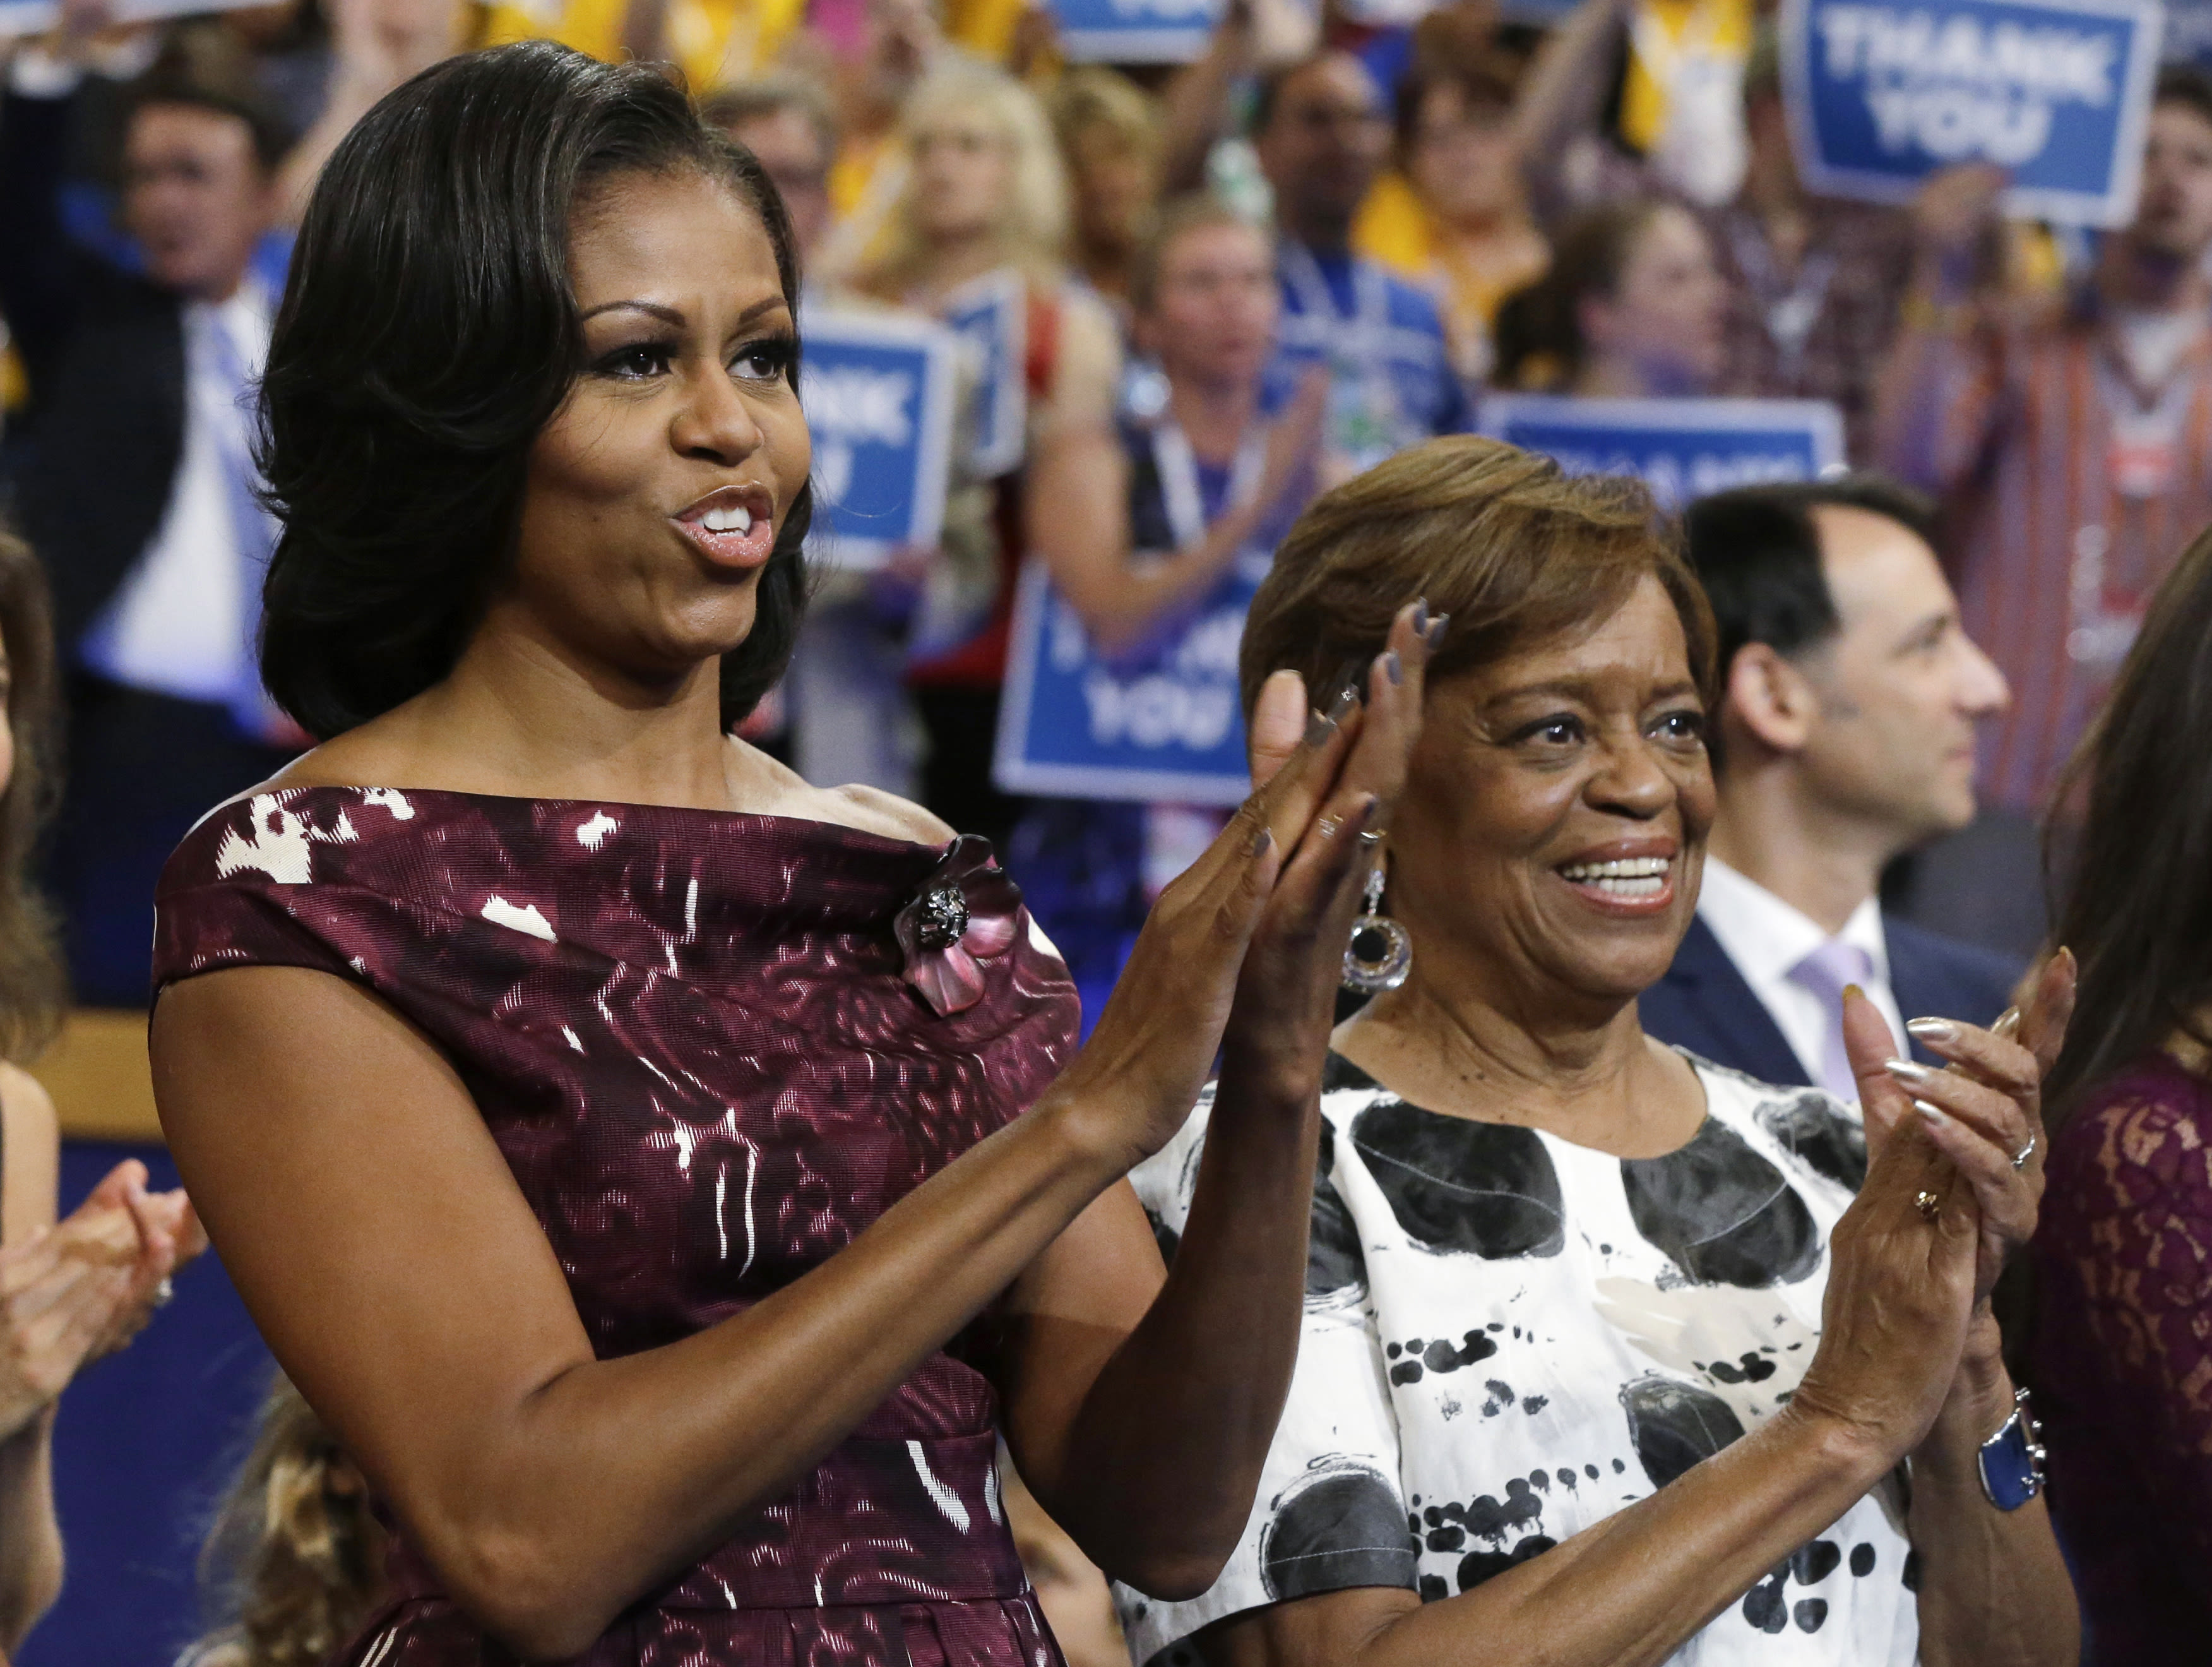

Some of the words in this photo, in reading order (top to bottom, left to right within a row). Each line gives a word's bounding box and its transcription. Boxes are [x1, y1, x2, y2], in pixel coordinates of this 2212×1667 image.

[1822, 5, 2117, 109] THANK
[1865, 90, 2054, 164] YOU
[1082, 667, 1234, 751] YOU
